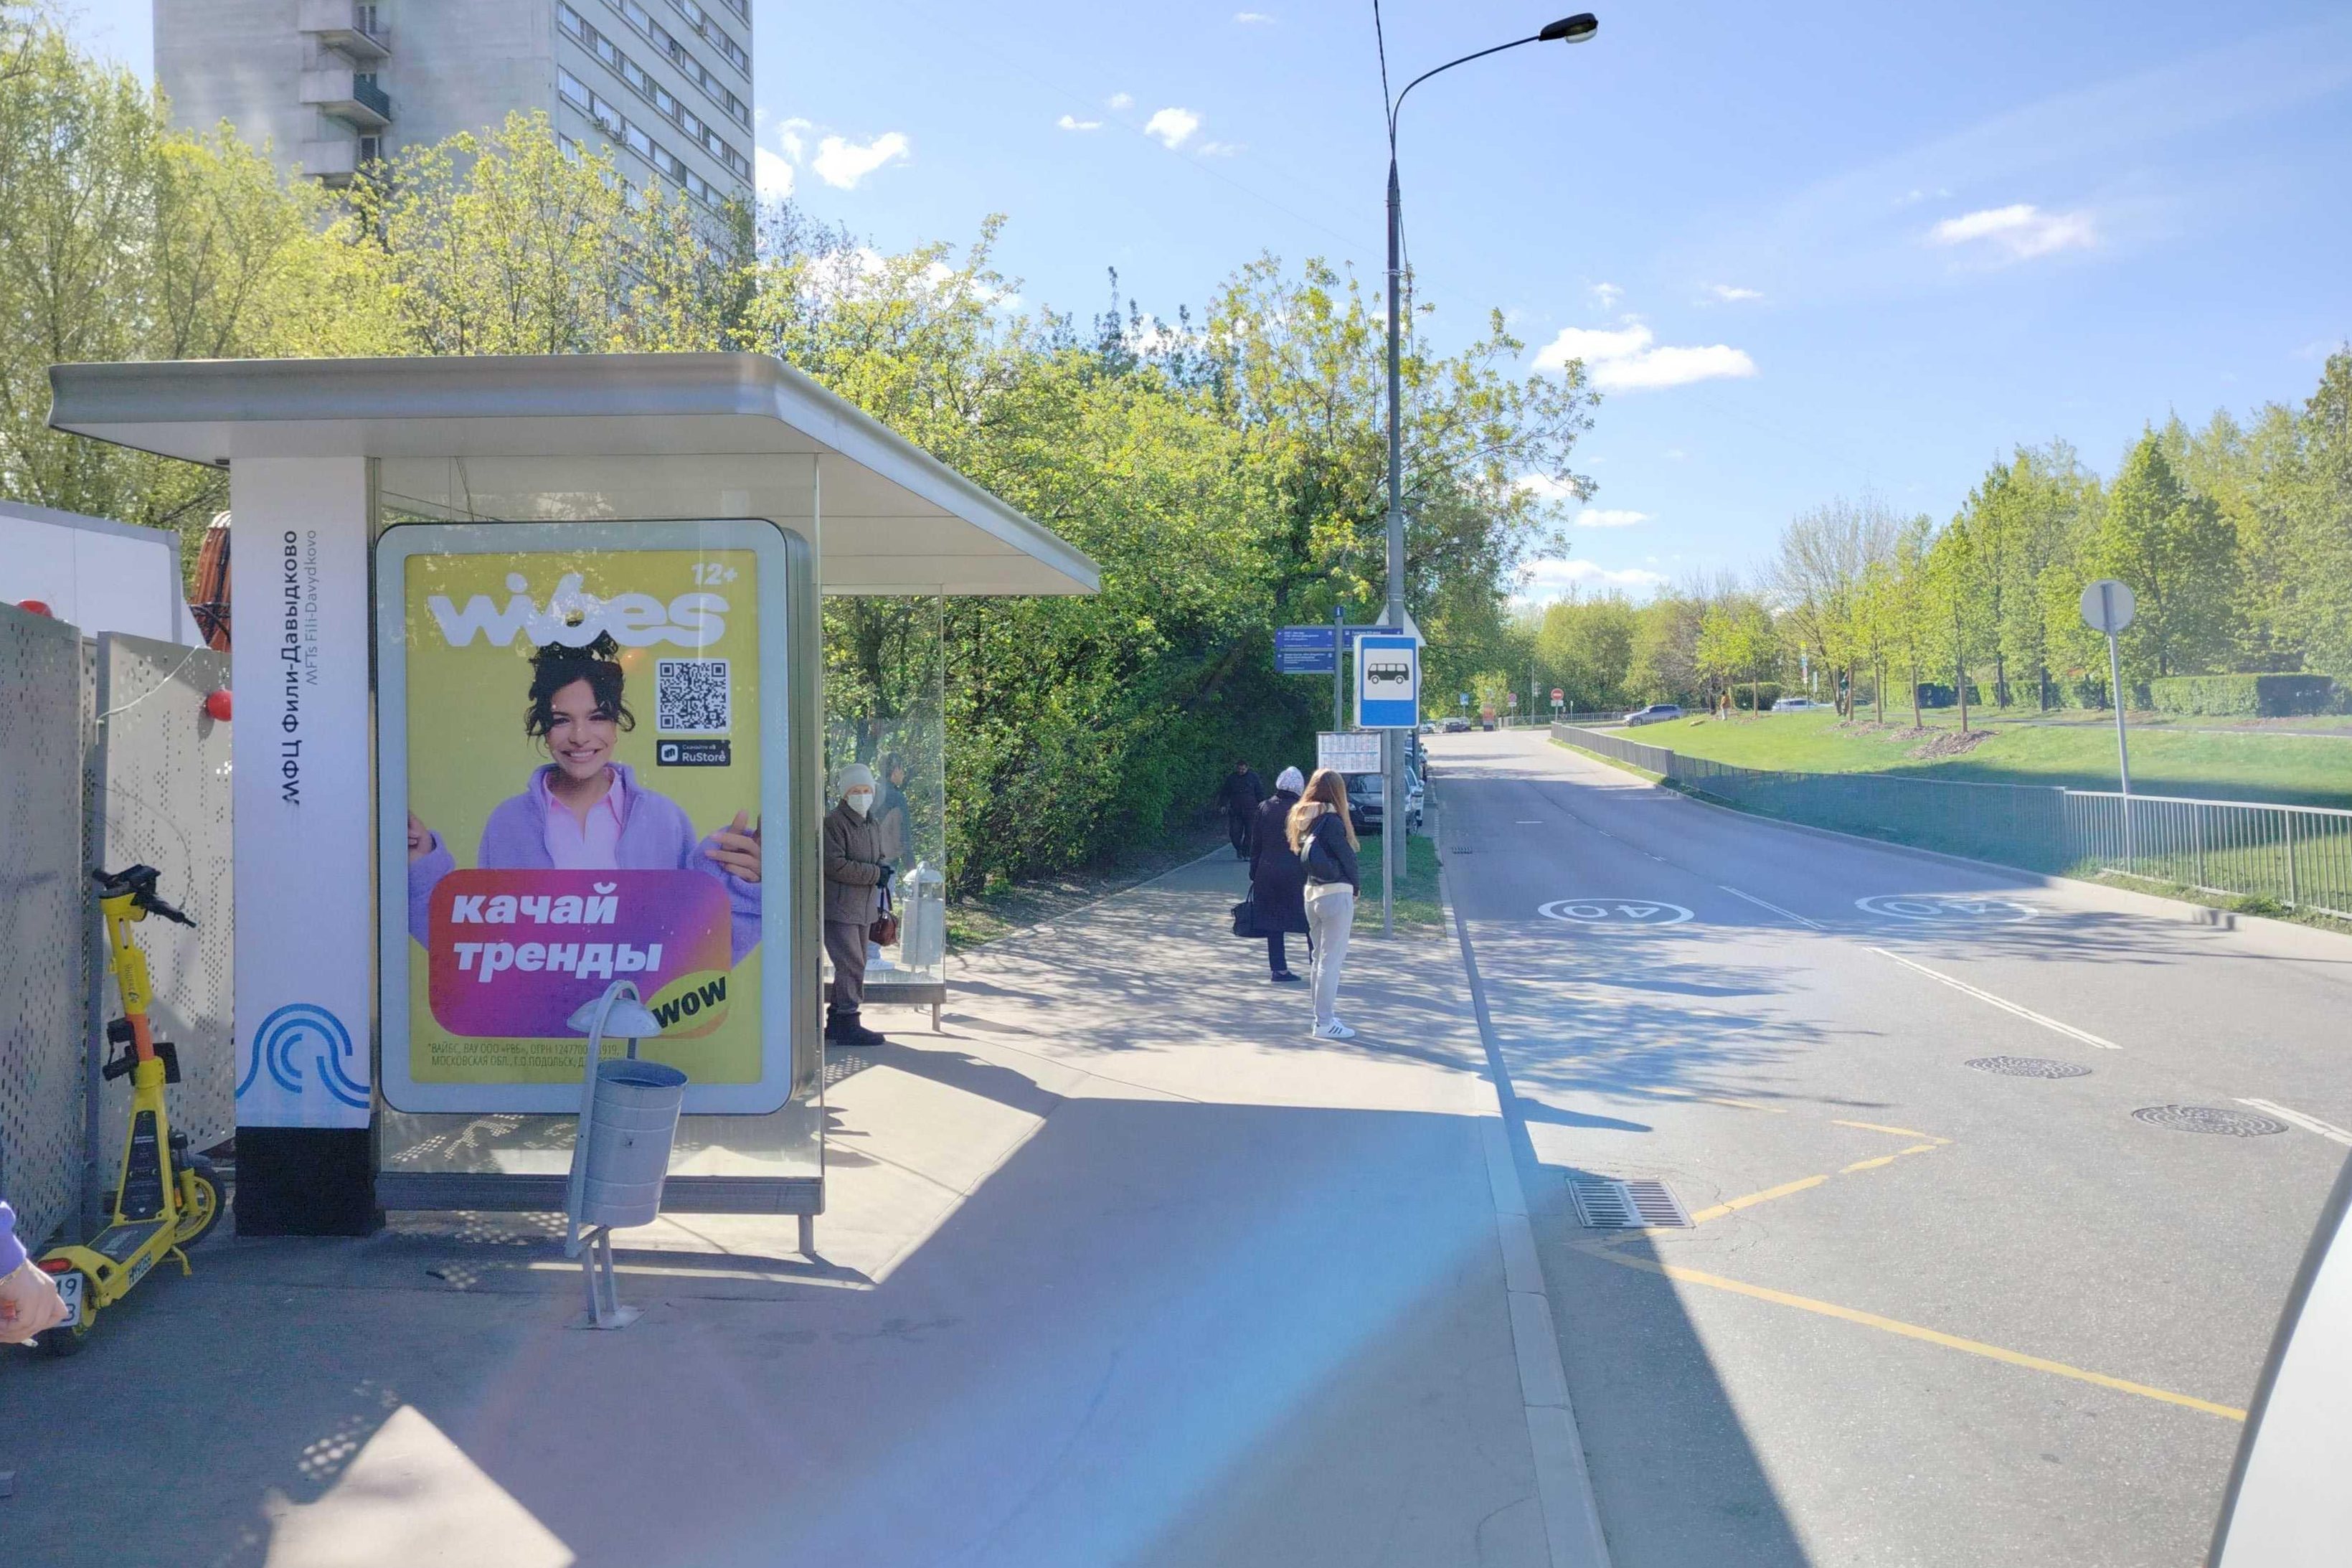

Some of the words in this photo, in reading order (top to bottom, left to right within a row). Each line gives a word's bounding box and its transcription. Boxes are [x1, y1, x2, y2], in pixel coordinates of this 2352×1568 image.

[304, 530, 319, 641] Fili-Davydkovo
[691, 563, 737, 585] 12+
[281, 530, 301, 733] Фили-Давыдково
[305, 646, 318, 685] MFTs
[281, 738, 302, 805] МФЦ
[682, 752, 726, 762] RuStore
[450, 882, 619, 924] качай
[1564, 905, 1660, 918] 40
[453, 941, 662, 983] тренды
[432, 1055, 488, 1067] МОСКОВСКАЯ
[481, 1043, 499, 1053] ООО
